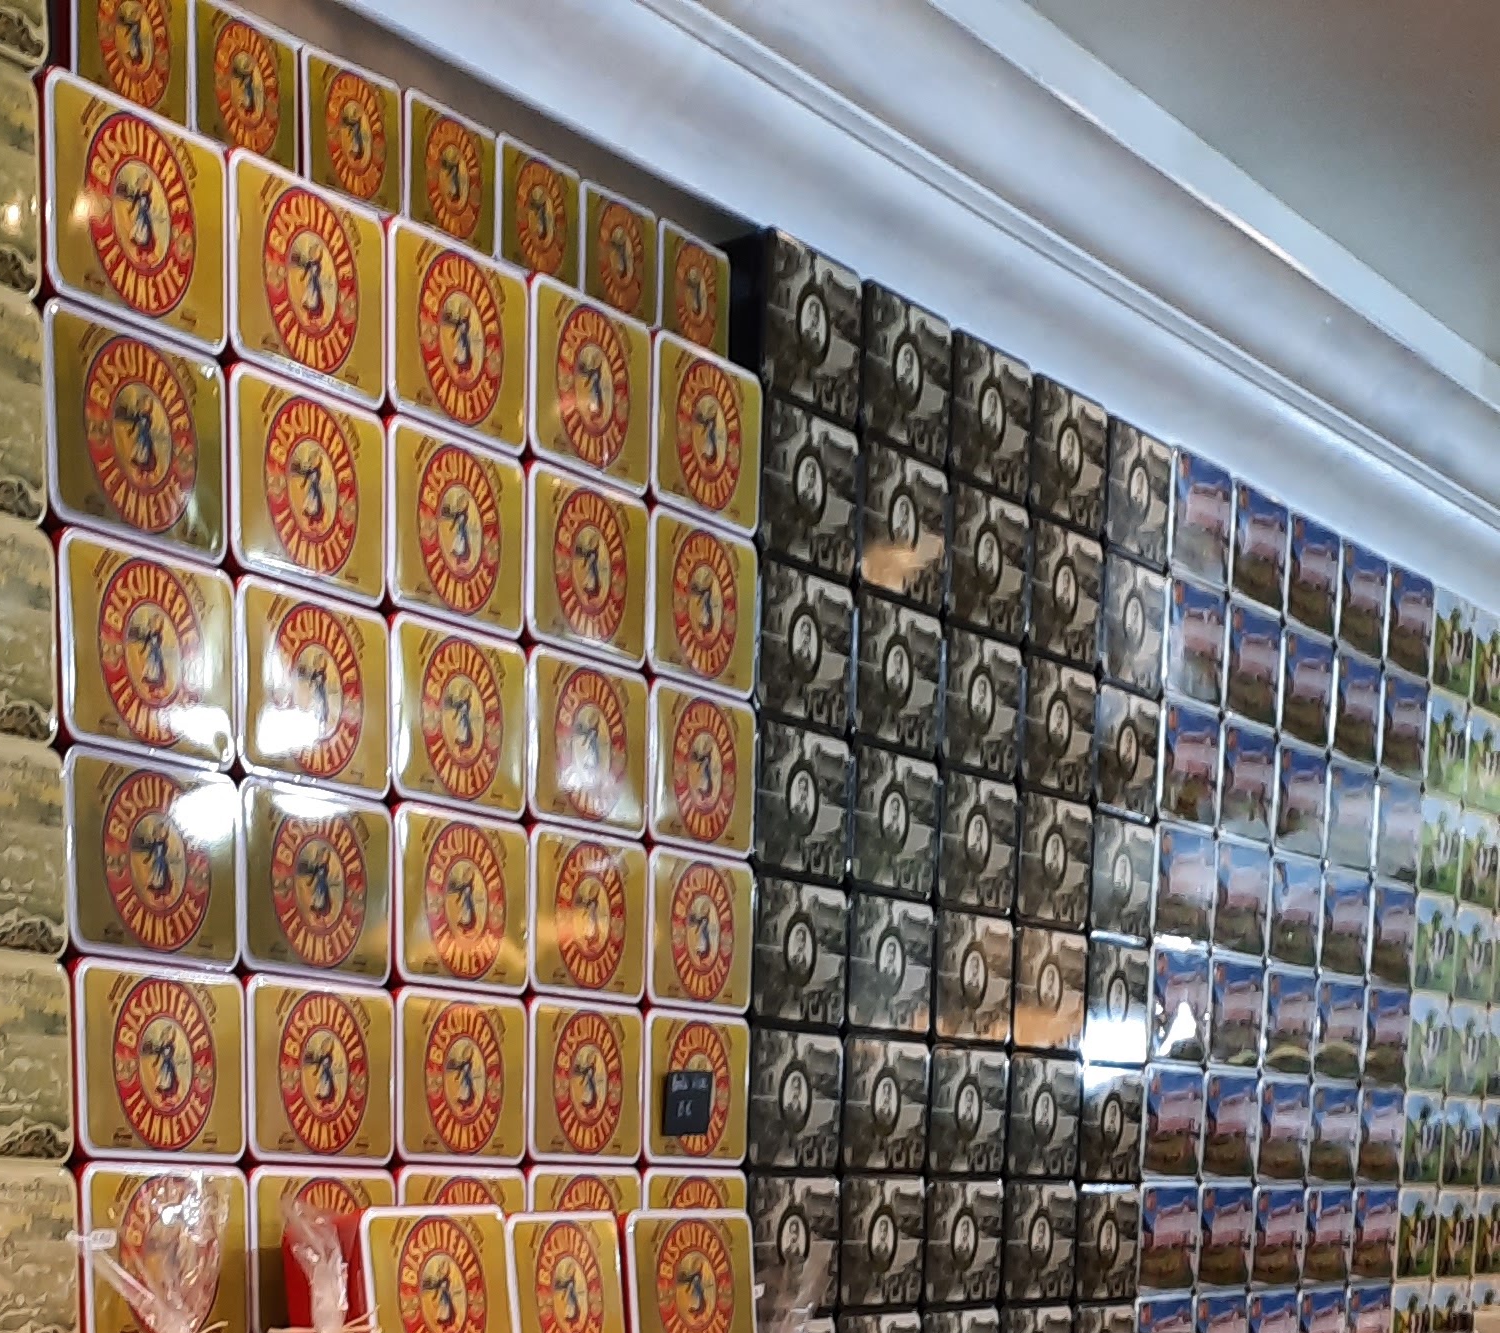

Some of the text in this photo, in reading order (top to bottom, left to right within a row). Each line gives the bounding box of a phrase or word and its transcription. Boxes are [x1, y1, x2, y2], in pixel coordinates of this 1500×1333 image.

[90, 115, 190, 215] BISCUITERIE
[268, 192, 355, 282] BISCUITERIE
[88, 342, 190, 432] BISCUITERIE
[269, 401, 354, 491] BISCUITERIE
[280, 606, 359, 687] ISCUITERIE
[115, 888, 208, 951] JEANNETTE
[279, 910, 361, 968] JEANNETTE
[115, 981, 211, 1053] BISCUITERIE
[283, 994, 367, 1062] BISCUITERIE
[429, 1004, 499, 1067] BISCUITERIE
[126, 1093, 209, 1148] JEANNETTE
[290, 1095, 362, 1153] JEANNETTE
[402, 1218, 479, 1284] BISCUITERIE
[538, 1221, 598, 1286] BISCUITERIE
[659, 1221, 731, 1281] BISCUITERIE
